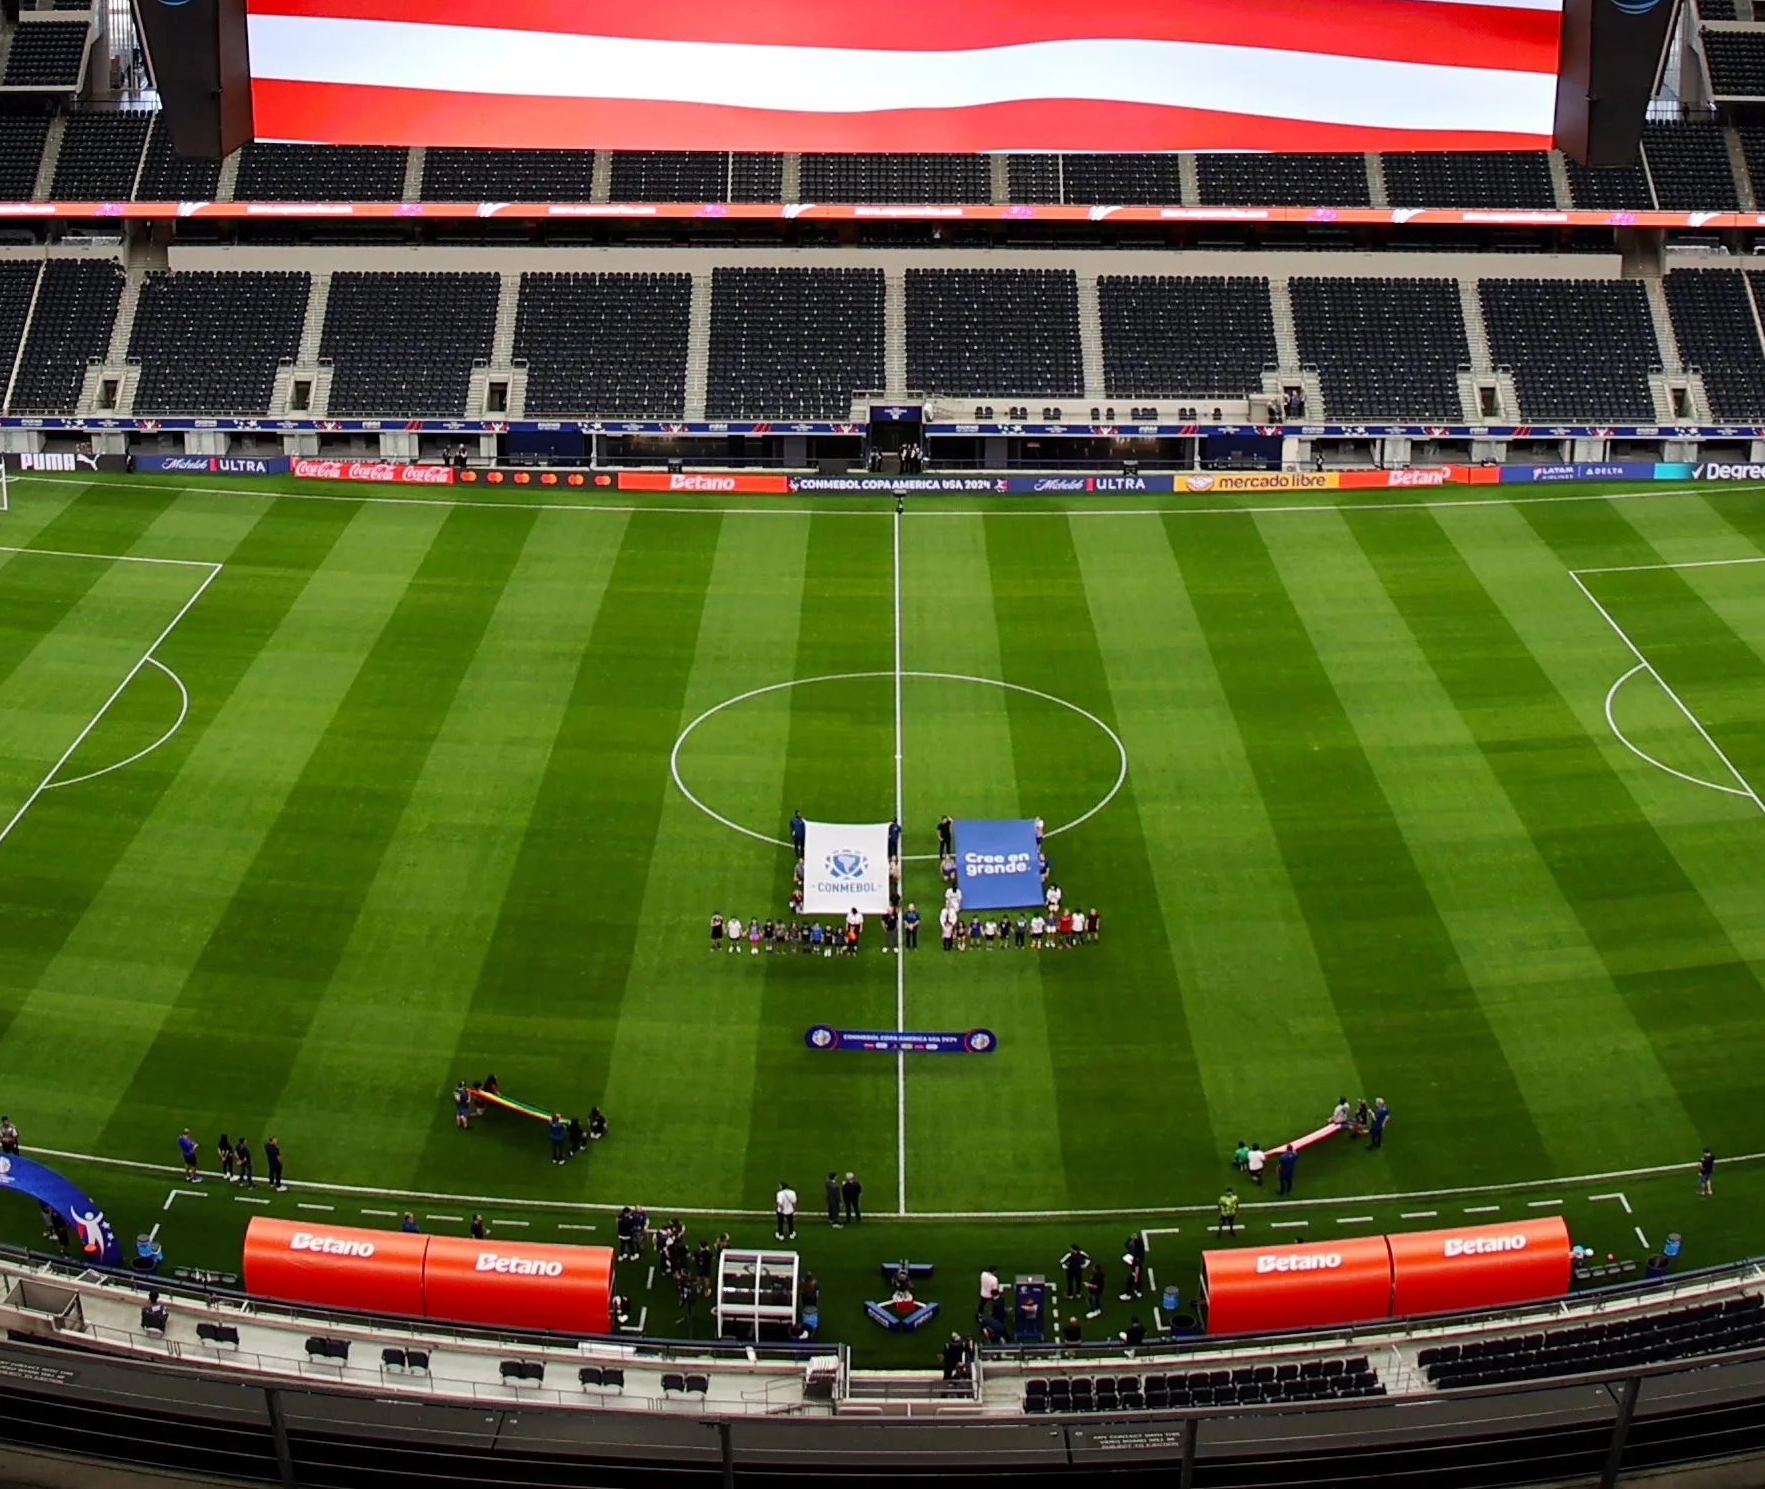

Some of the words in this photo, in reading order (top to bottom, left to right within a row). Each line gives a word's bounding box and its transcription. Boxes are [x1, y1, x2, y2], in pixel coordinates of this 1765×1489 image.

[21, 454, 76, 471] PUMA
[161, 456, 208, 471] Michelob
[220, 457, 267, 472] ULTRA
[295, 461, 341, 477] Coca-Cola
[348, 464, 396, 481] Coca-Cola
[402, 465, 451, 484] Coca-Cola
[1388, 466, 1451, 485] Betano
[1542, 466, 1575, 475] LATAM
[1595, 466, 1624, 476] DELTA
[671, 474, 736, 491] Betano
[801, 478, 860, 490] CONMEBOL
[861, 478, 891, 490] COPA
[891, 478, 940, 490] AMERICA
[942, 478, 963, 490] USA
[964, 478, 990, 490] 2024
[1034, 478, 1084, 492] Michelob
[1096, 478, 1146, 491] ULTRA
[1219, 475, 1289, 489] mercado
[1290, 474, 1326, 488] libre
[965, 852, 1005, 864] Cree
[1007, 852, 1030, 863] en
[965, 862, 1032, 876] grande.
[818, 881, 877, 894] CONMEBOL
[290, 1230, 373, 1258] Betano
[1445, 1230, 1526, 1257] Betano
[475, 1252, 562, 1278] Betano
[1256, 1251, 1341, 1274] Betano
